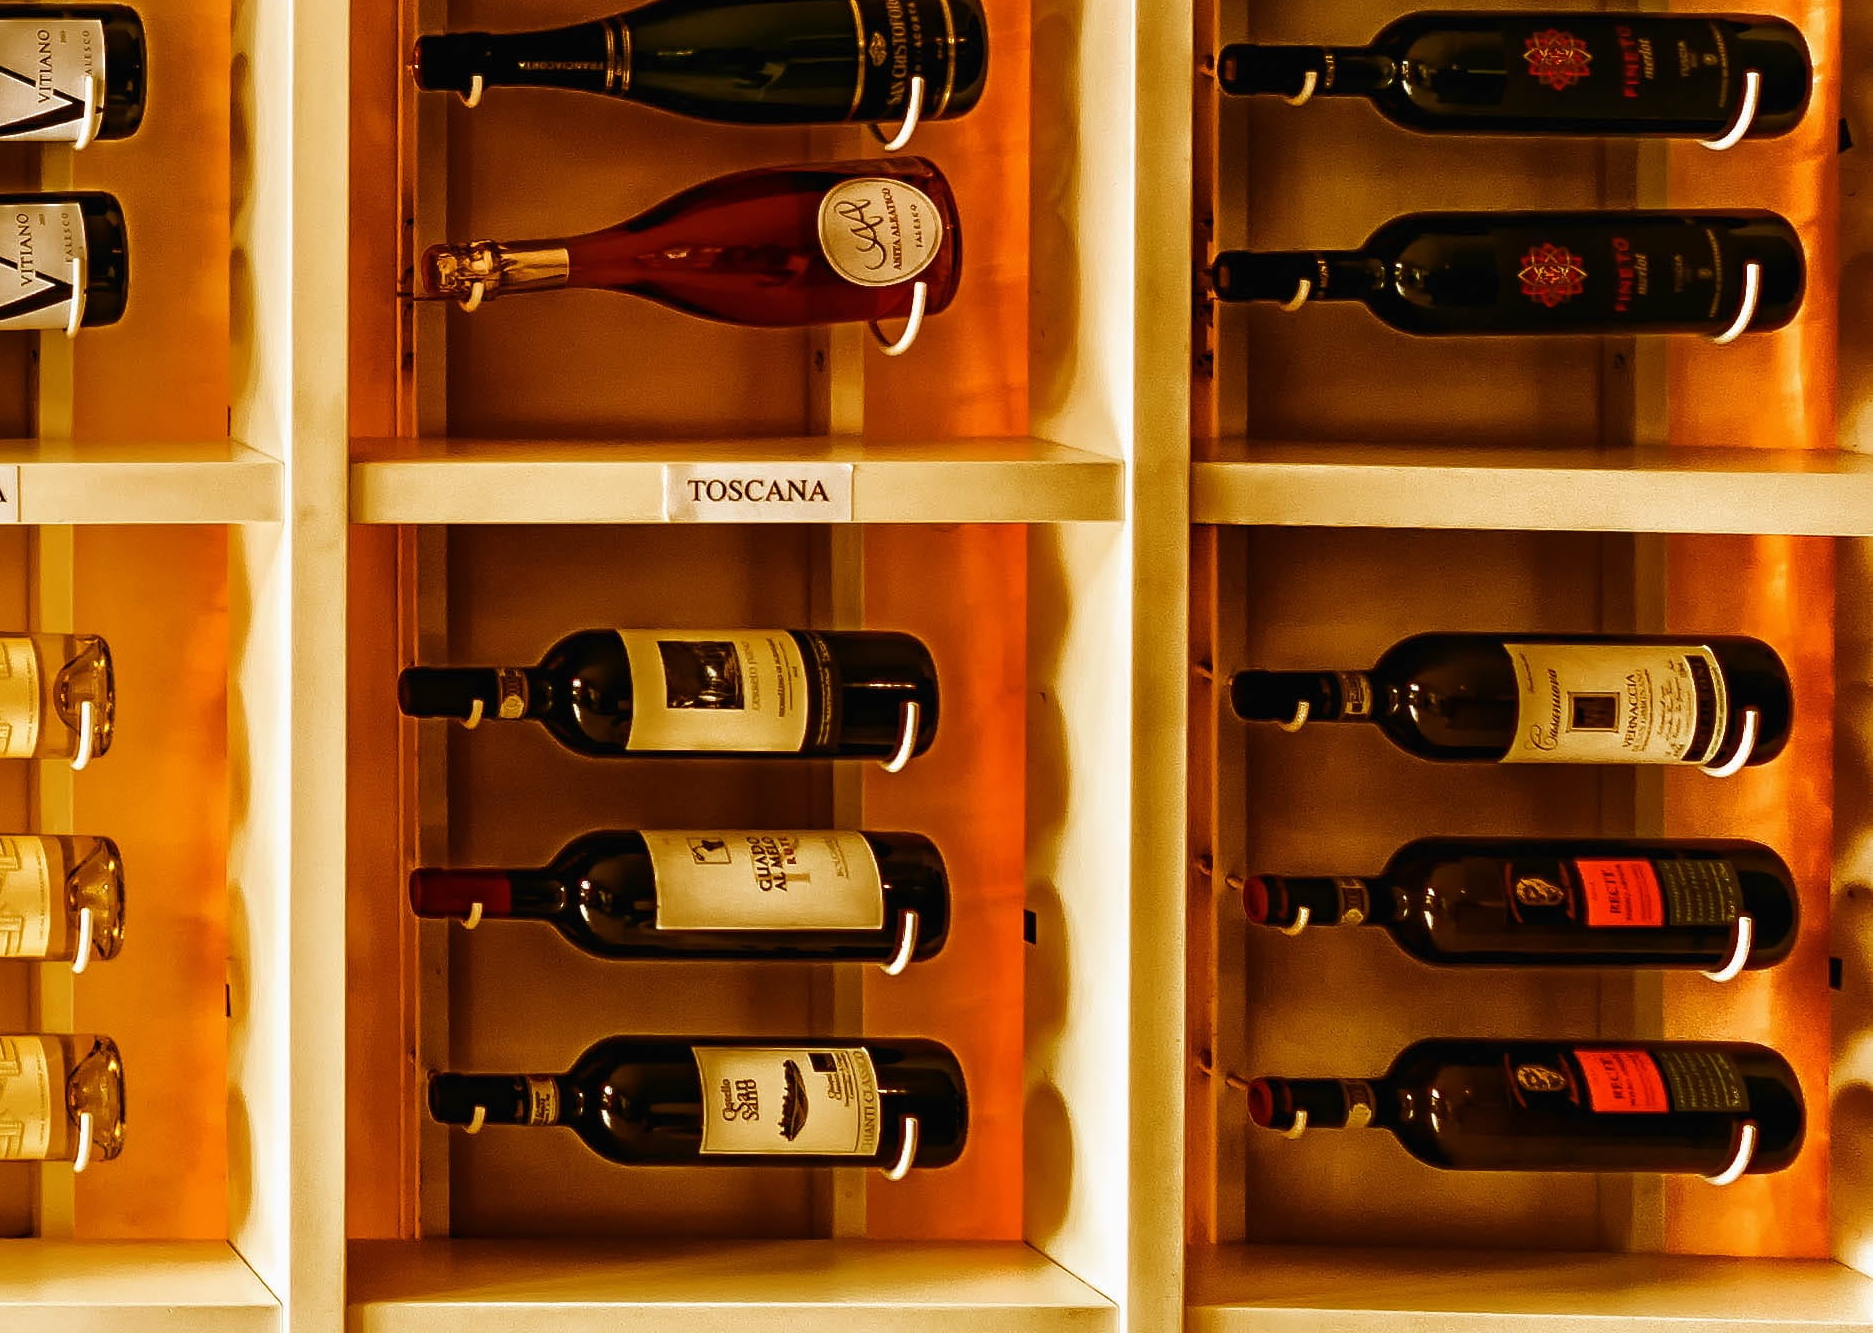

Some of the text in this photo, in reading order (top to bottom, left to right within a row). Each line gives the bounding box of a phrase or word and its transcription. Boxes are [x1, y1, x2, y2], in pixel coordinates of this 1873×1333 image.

[36, 29, 53, 104] VITIANO
[1638, 39, 1654, 79] merlot
[886, 81, 906, 106] SAN
[16, 213, 34, 286] VITIANO
[60, 213, 74, 263] FALESCO
[881, 187, 903, 270] ANITA ALEATICO
[687, 479, 830, 502] TOSCANA
[1621, 674, 1638, 748] VERNACCIA
[748, 836, 771, 891] GUADO
[762, 836, 787, 892] AL MELO
[733, 1079, 750, 1113] San
[745, 1079, 759, 1121] Sano
